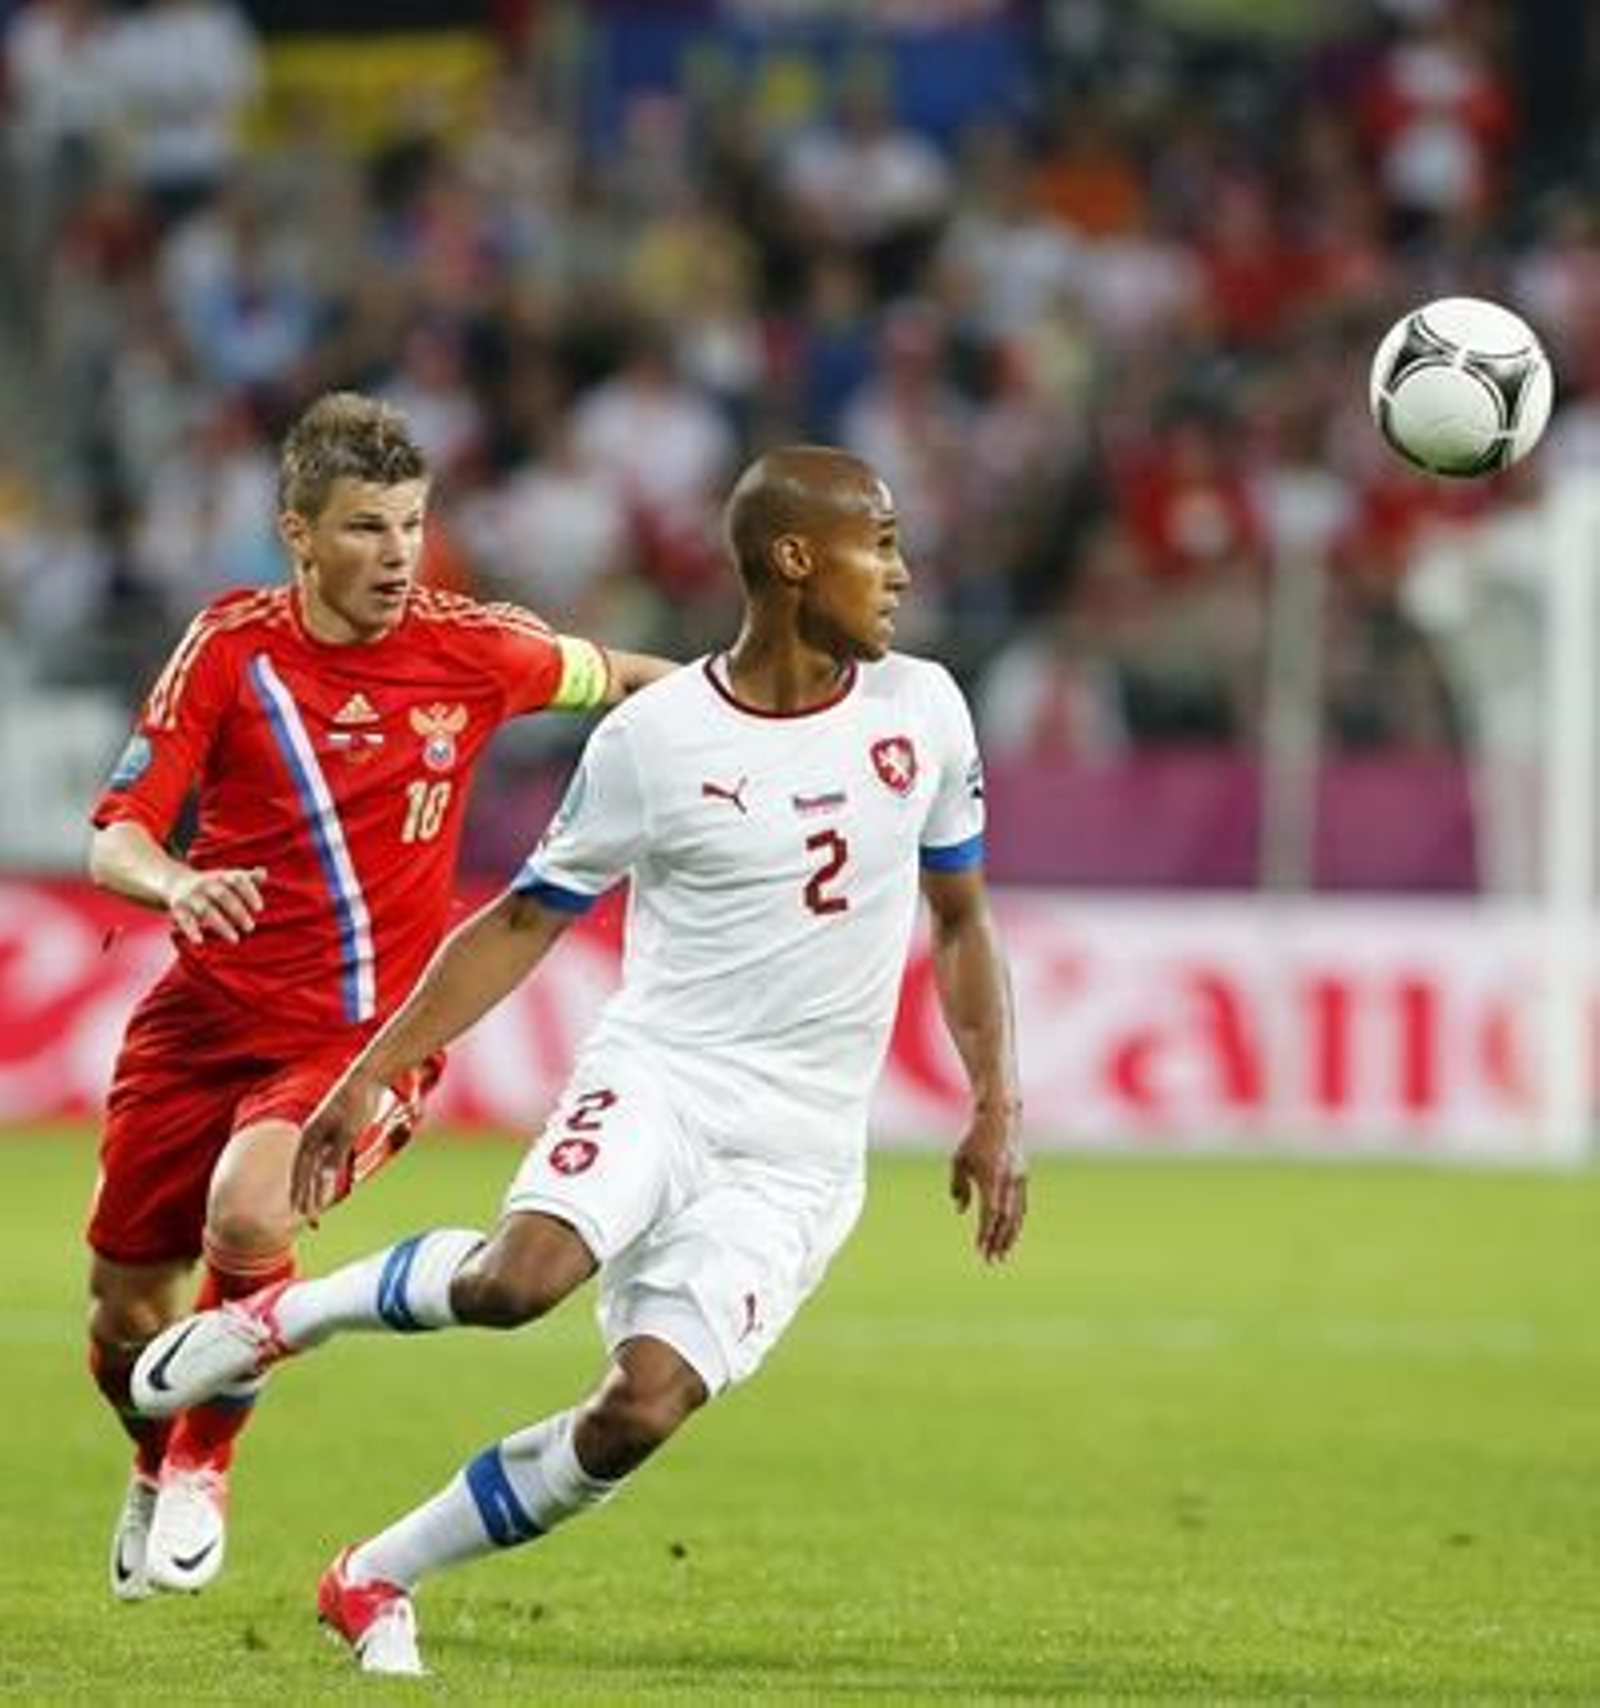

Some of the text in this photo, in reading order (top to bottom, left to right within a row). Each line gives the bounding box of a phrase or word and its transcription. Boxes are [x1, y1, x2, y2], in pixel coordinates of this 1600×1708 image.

[401, 781, 452, 844] 10
[804, 829, 848, 915] 2
[566, 1088, 617, 1132] 2
